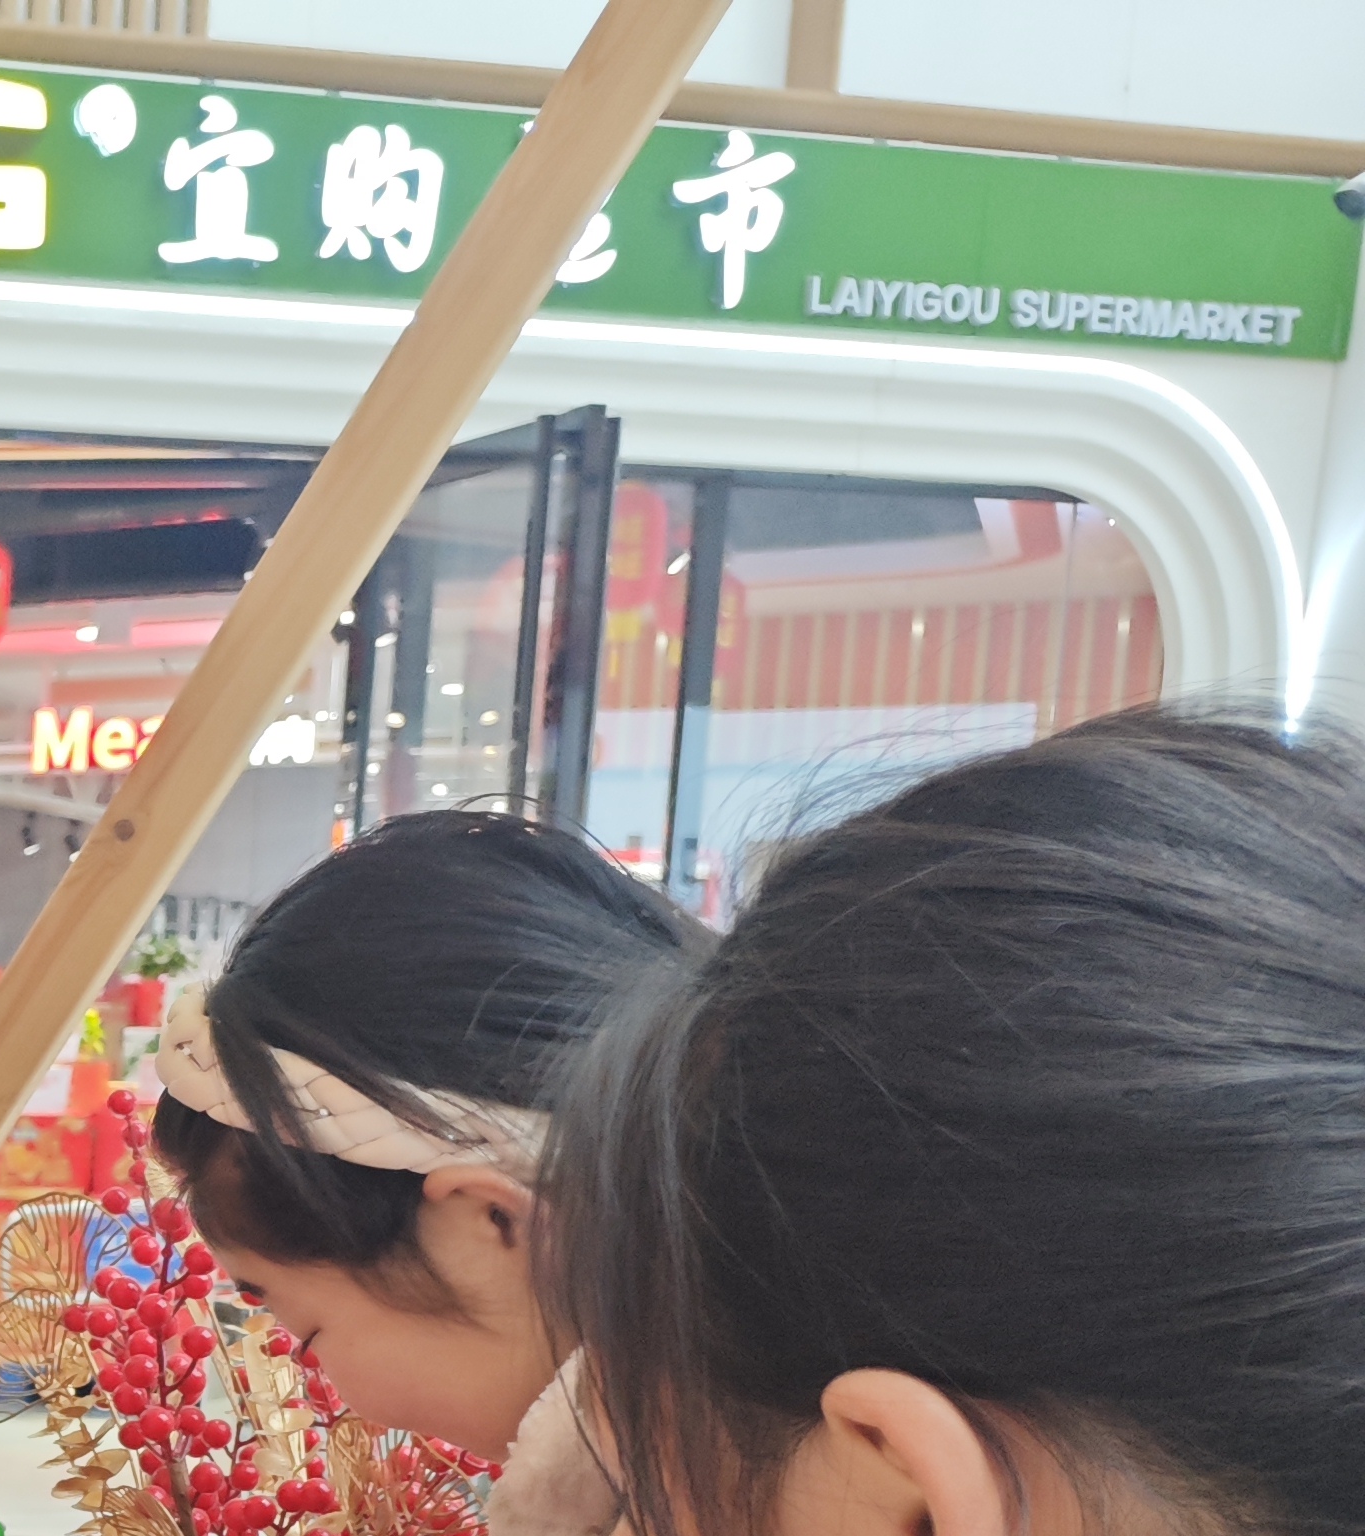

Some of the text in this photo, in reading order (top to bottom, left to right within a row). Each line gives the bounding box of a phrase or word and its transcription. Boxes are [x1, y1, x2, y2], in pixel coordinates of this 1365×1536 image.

[158, 95, 797, 310] 宜购市
[805, 275, 1303, 345] LAIYIGOU SUPERMARKET
